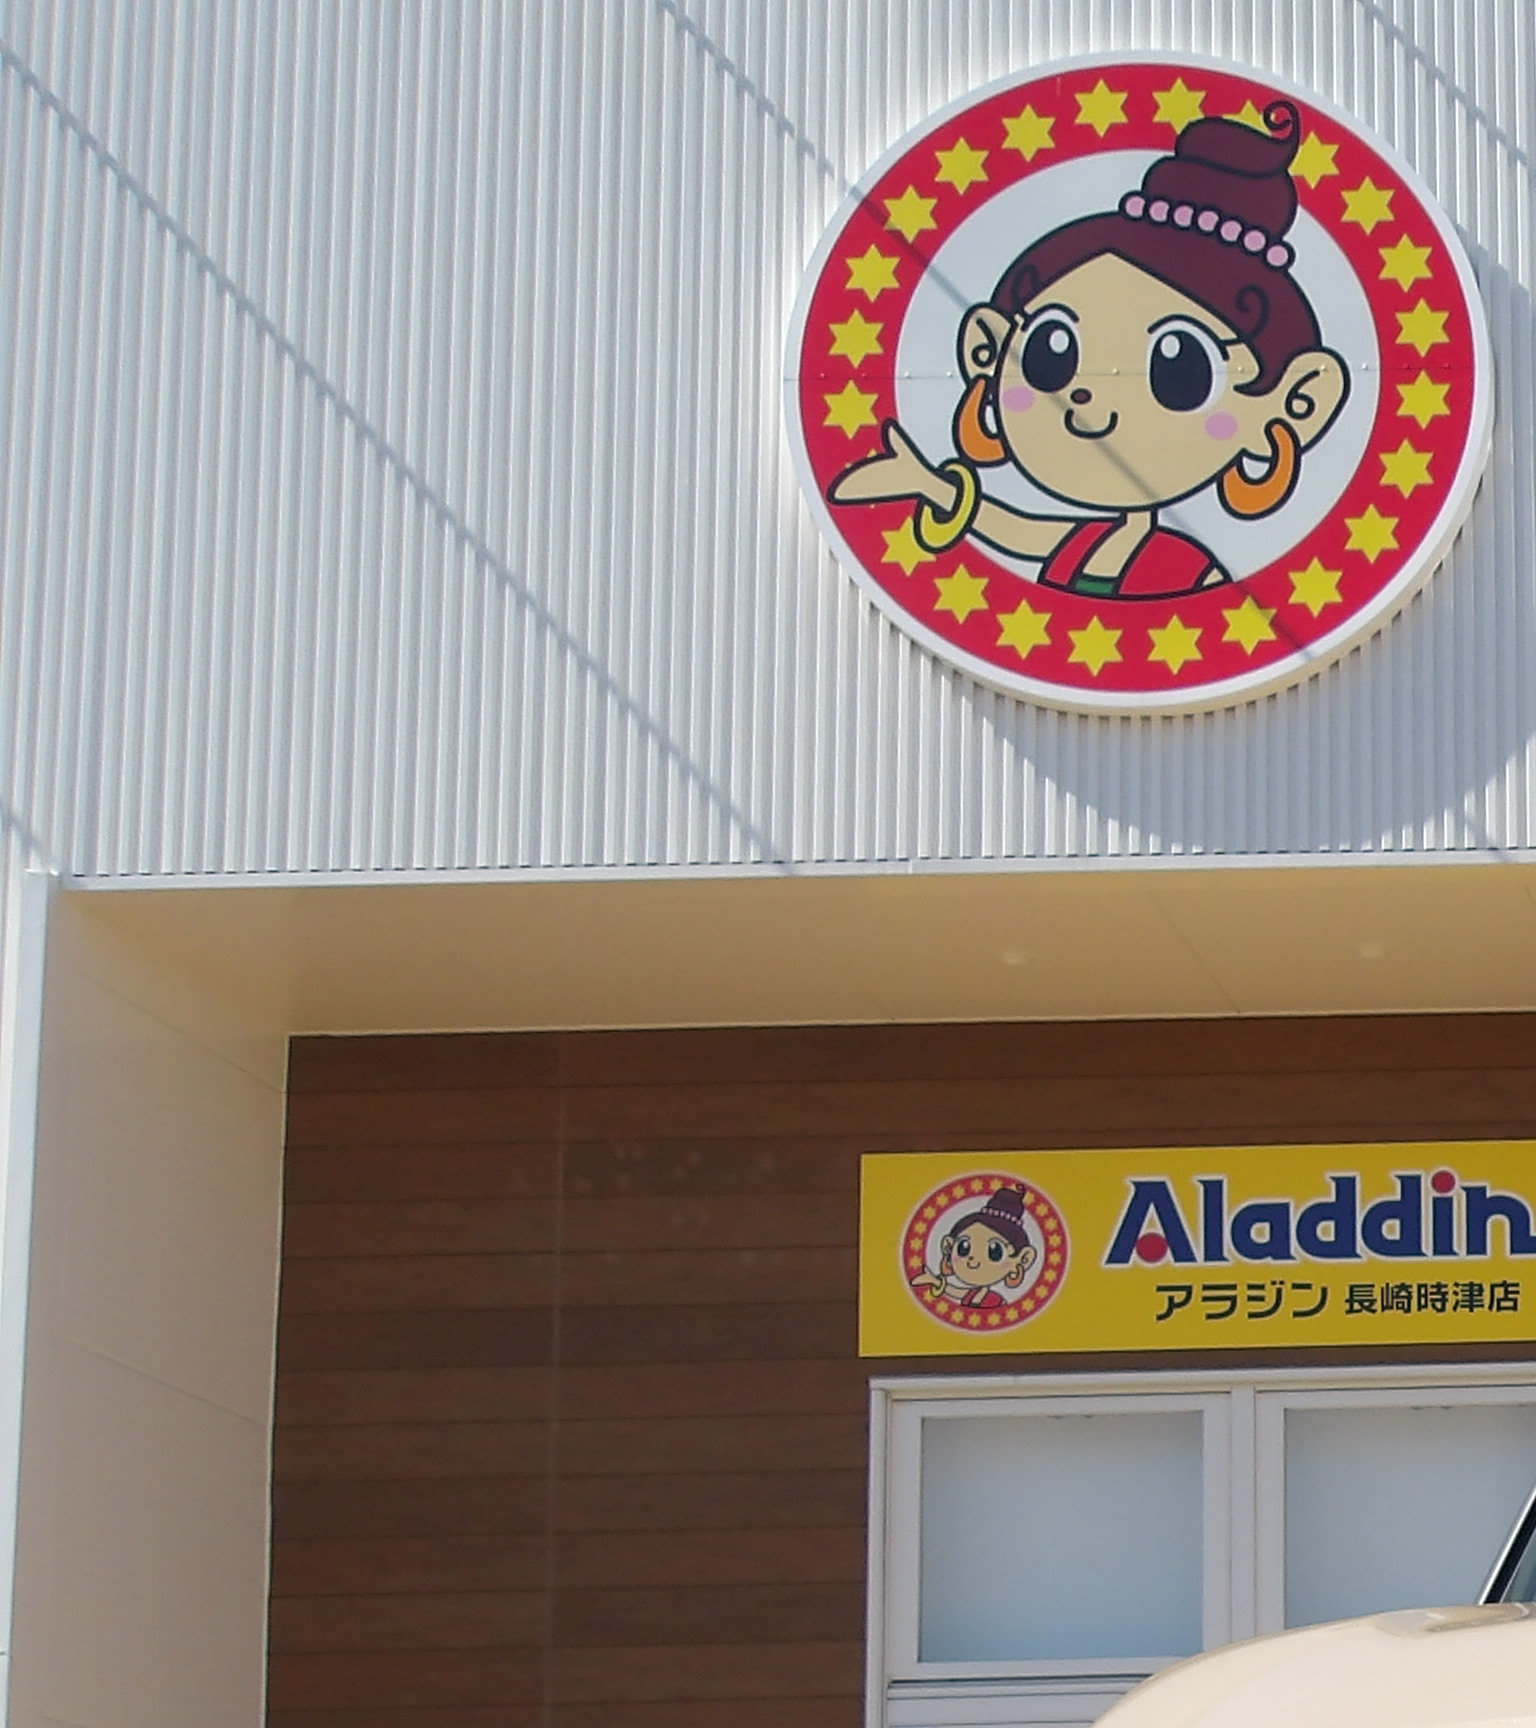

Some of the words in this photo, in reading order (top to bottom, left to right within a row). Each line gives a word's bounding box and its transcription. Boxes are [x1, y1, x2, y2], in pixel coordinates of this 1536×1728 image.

[1155, 1279, 1329, 1322] アラジン
[1344, 1280, 1521, 1316] 長崎時津店
